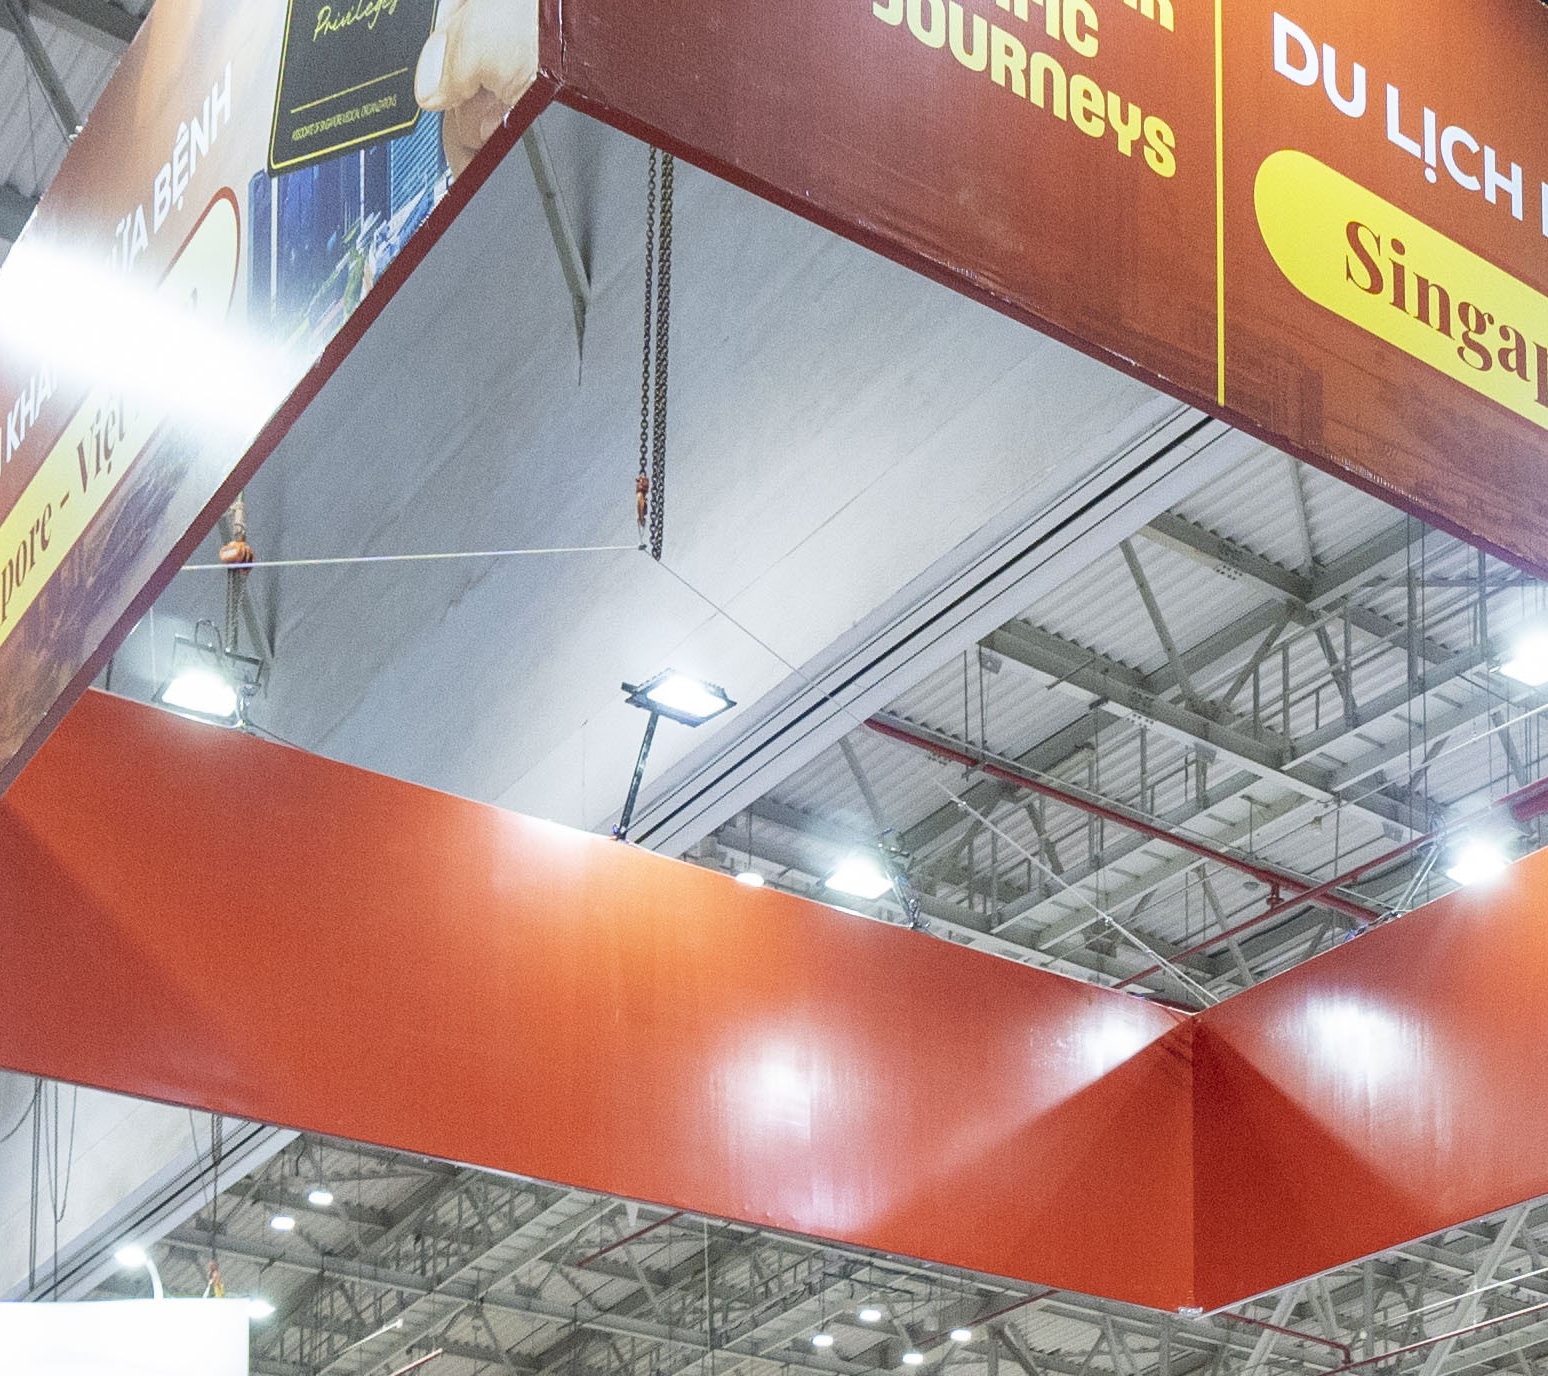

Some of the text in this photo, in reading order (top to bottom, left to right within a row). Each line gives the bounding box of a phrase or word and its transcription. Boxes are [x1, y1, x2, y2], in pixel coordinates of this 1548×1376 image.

[153, 61, 232, 234] BỆNH
[1274, 14, 1365, 117] DU
[1388, 82, 1526, 220] LỊCH
